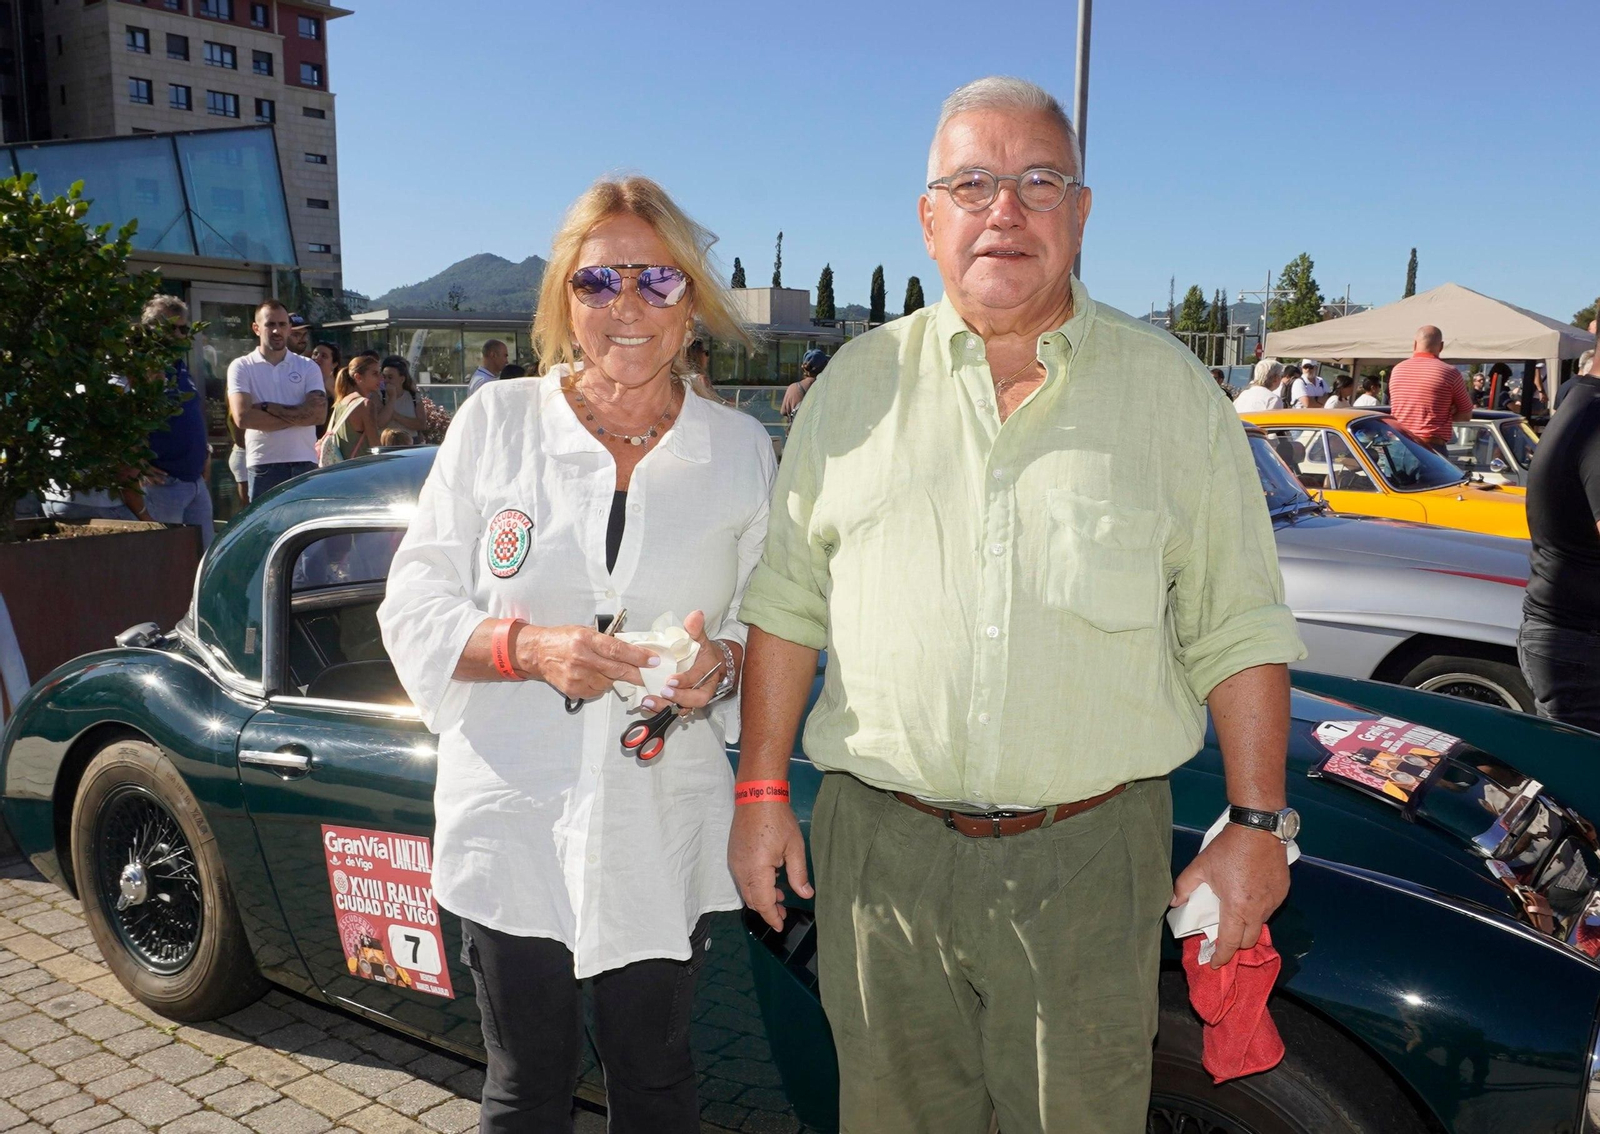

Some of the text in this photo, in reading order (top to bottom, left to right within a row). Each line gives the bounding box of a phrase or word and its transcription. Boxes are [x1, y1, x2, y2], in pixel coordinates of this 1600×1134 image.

[498, 520, 518, 530] VIGO
[1324, 723, 1348, 733] 7
[749, 788, 765, 798] Vigo
[324, 831, 432, 874] GranVía LANZAL
[345, 856, 374, 872] de Vigo
[349, 875, 384, 901] XVIII
[386, 881, 433, 909] RALLY
[335, 893, 437, 927] CIUDAD DE VIGO
[339, 914, 375, 936] ESCUDERIA
[404, 934, 421, 964] 7
